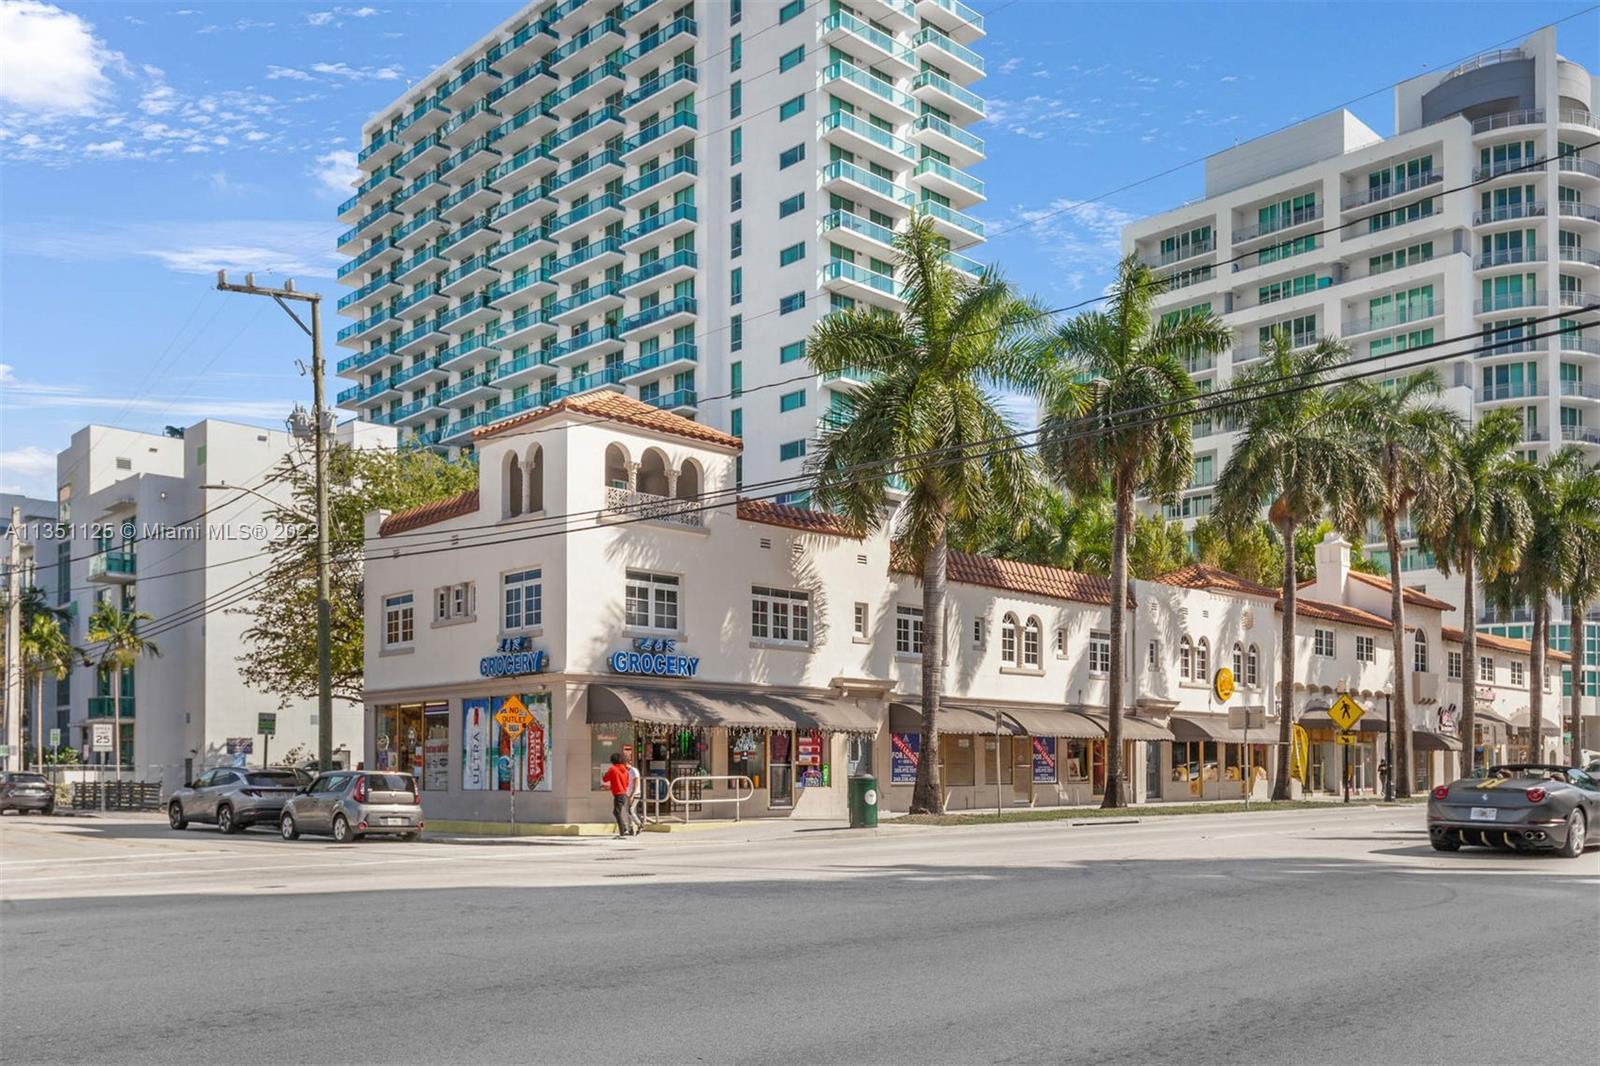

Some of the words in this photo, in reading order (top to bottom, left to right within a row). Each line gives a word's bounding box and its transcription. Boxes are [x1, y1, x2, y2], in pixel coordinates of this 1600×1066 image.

[480, 651, 542, 677] GROCERY
[613, 651, 699, 676] GROCERY
[95, 735, 110, 744] 25
[472, 732, 480, 785] ULTRA
